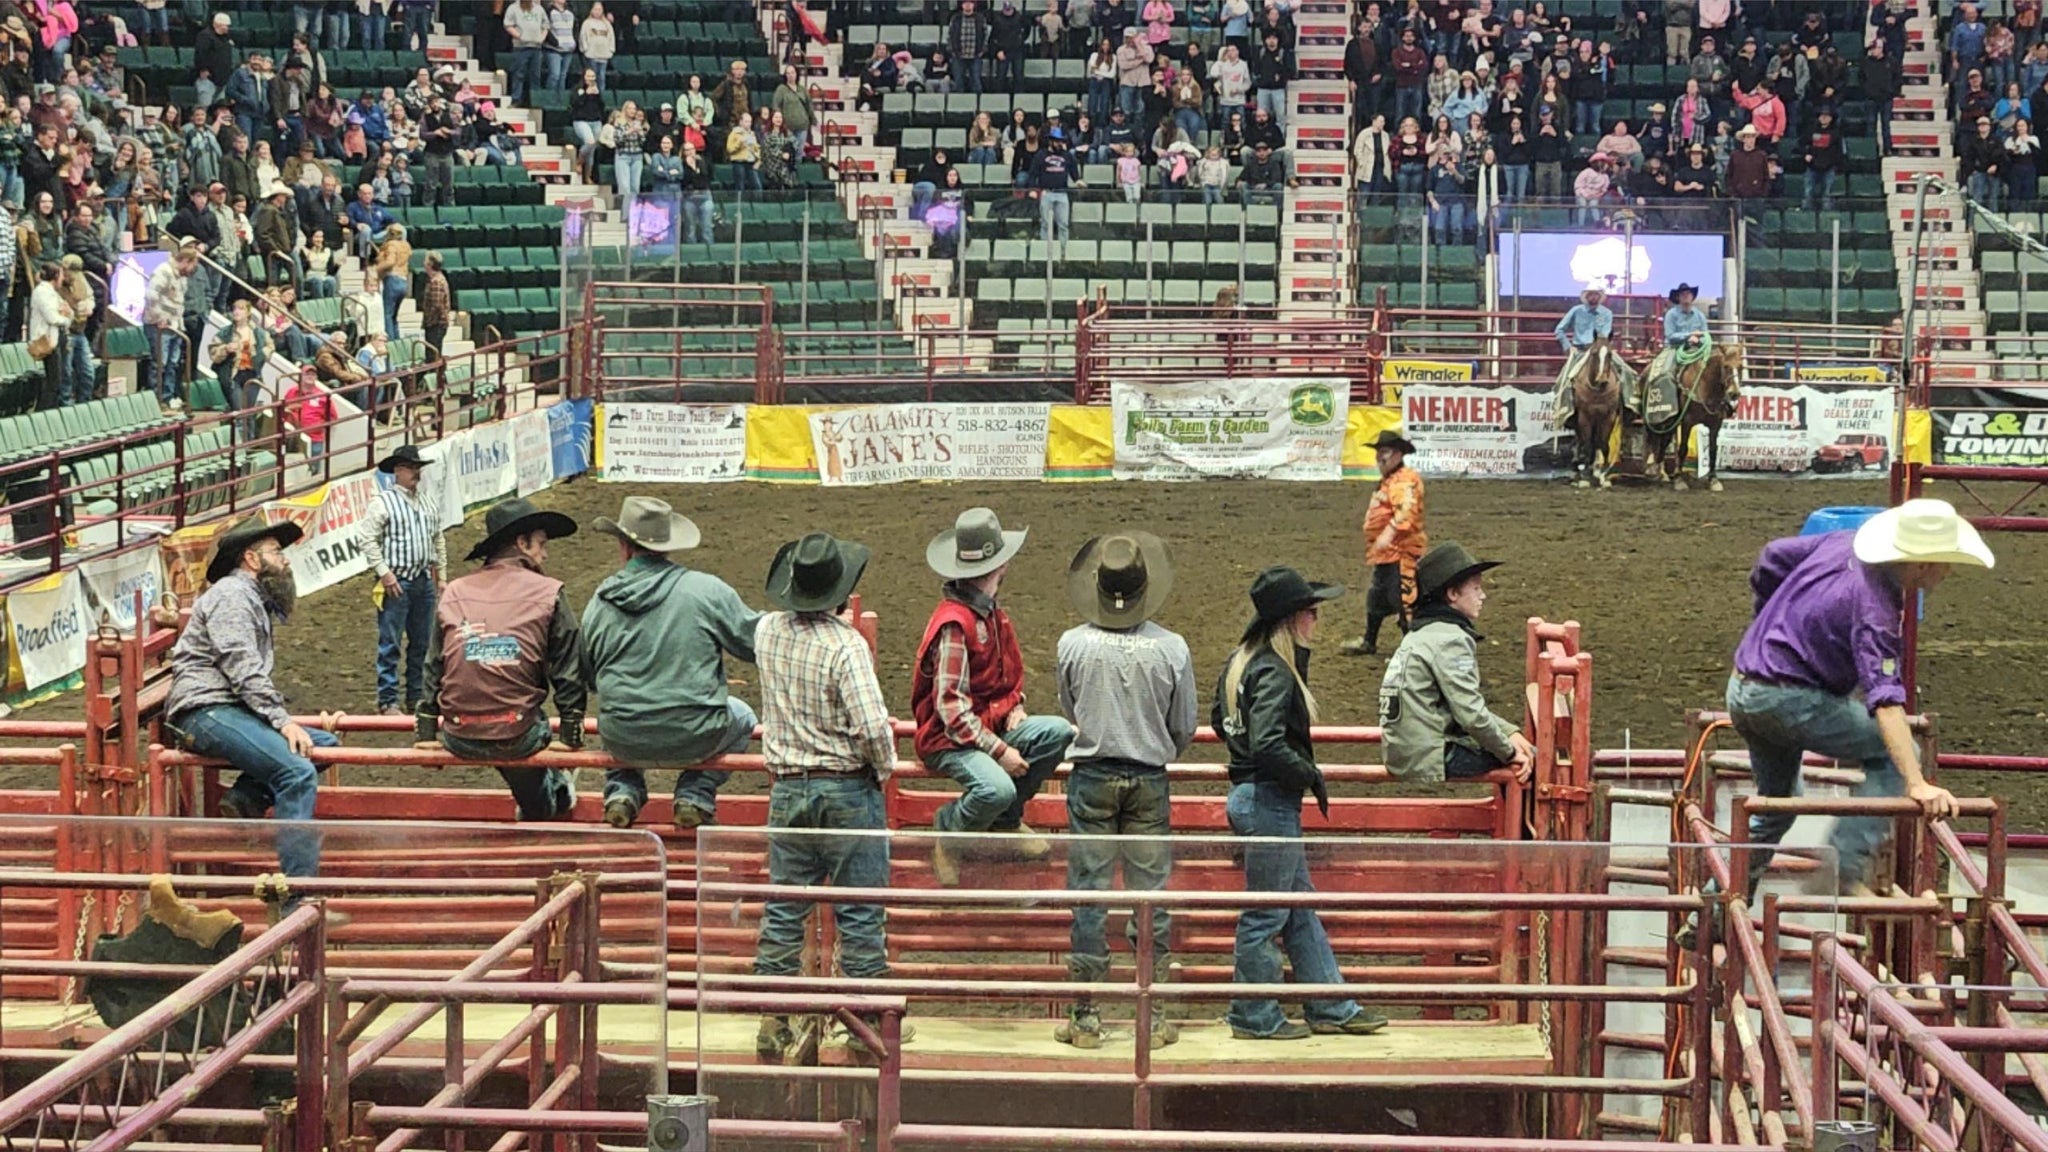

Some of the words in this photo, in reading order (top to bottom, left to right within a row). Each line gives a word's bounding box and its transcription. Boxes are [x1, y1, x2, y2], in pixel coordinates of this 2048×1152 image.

[1394, 365, 1464, 381] Wrangler
[1408, 396, 1503, 423] NEMER
[1733, 395, 1795, 422] MER
[1833, 398, 1851, 409] THE
[1852, 398, 1875, 409] BEST
[850, 407, 952, 433] CALAMITY
[1824, 409, 1851, 419] DEALS
[1852, 409, 1870, 419] ARE
[1872, 410, 1884, 420] AT
[957, 419, 1046, 432] 518-832-4867
[1169, 418, 1206, 434] Farm
[1222, 418, 1269, 433] Garden
[843, 431, 952, 469] JANE'S
[958, 444, 990, 455] RIFLES
[997, 444, 1046, 455] SHOTGUNS
[1943, 437, 2048, 454] TOWIN
[976, 455, 1028, 466] HANDGUNS
[1083, 628, 1158, 653] Wrangler
